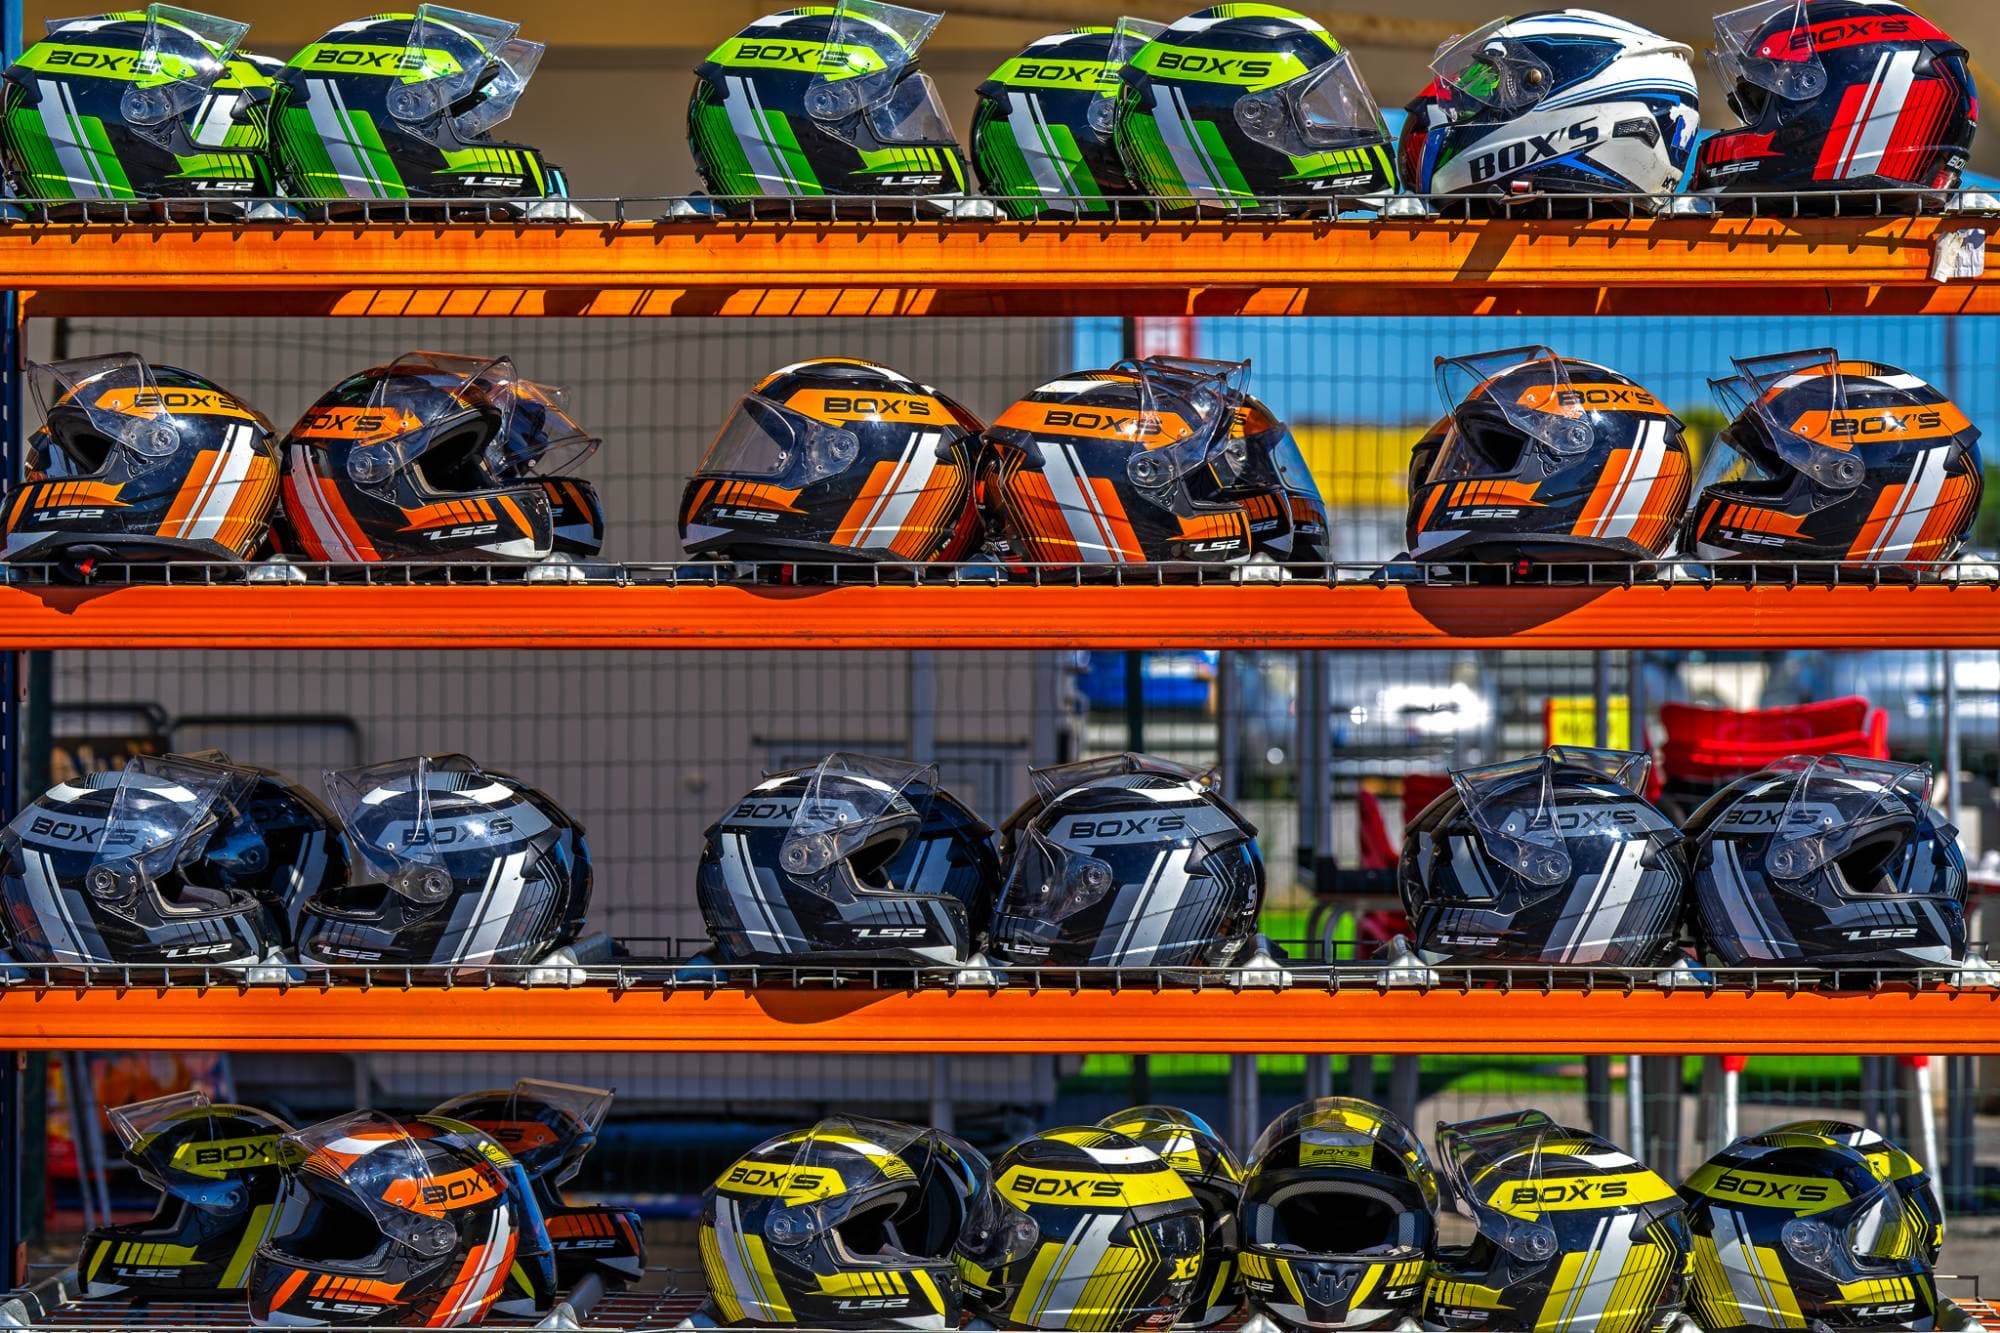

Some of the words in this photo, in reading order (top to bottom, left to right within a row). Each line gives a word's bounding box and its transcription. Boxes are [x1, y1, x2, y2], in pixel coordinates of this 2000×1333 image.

[1790, 20, 1909, 52] BOX'S
[1157, 52, 1273, 78] BOX'S
[1468, 116, 1599, 183] BOX'S
[1706, 160, 1760, 178] LS2
[190, 180, 254, 191] LS2
[458, 176, 524, 188] LS2
[876, 175, 942, 186] LS2
[1306, 173, 1373, 191] LS2
[134, 393, 239, 411] BOX'S
[1555, 389, 1654, 407] BOX'S
[824, 397, 931, 416] BOX'S
[1830, 411, 1942, 437] BOX'S
[33, 509, 105, 521] LS2
[712, 508, 780, 523] LS2
[1446, 509, 1520, 520] LS2
[423, 524, 498, 541] LS2
[1249, 520, 1278, 532] S2
[1189, 540, 1241, 552] LS2
[1719, 530, 1786, 547] LS2
[401, 816, 513, 846] BOXS
[1069, 815, 1186, 839] BOX'S
[852, 928, 927, 938] LS2
[1437, 934, 1499, 946] LS2
[1842, 927, 1919, 940] LS2
[160, 943, 232, 958] LS2
[317, 945, 382, 960] LS2
[1000, 943, 1051, 956] LS2
[1011, 1174, 1123, 1197] BOX'S
[1511, 1181, 1627, 1205] BOX'S
[1714, 1175, 1828, 1202] BOX'S
[112, 1267, 182, 1279] LS2
[305, 1299, 383, 1314] LS2
[832, 1298, 910, 1309] LS2
[1852, 1304, 1916, 1317] LS2
